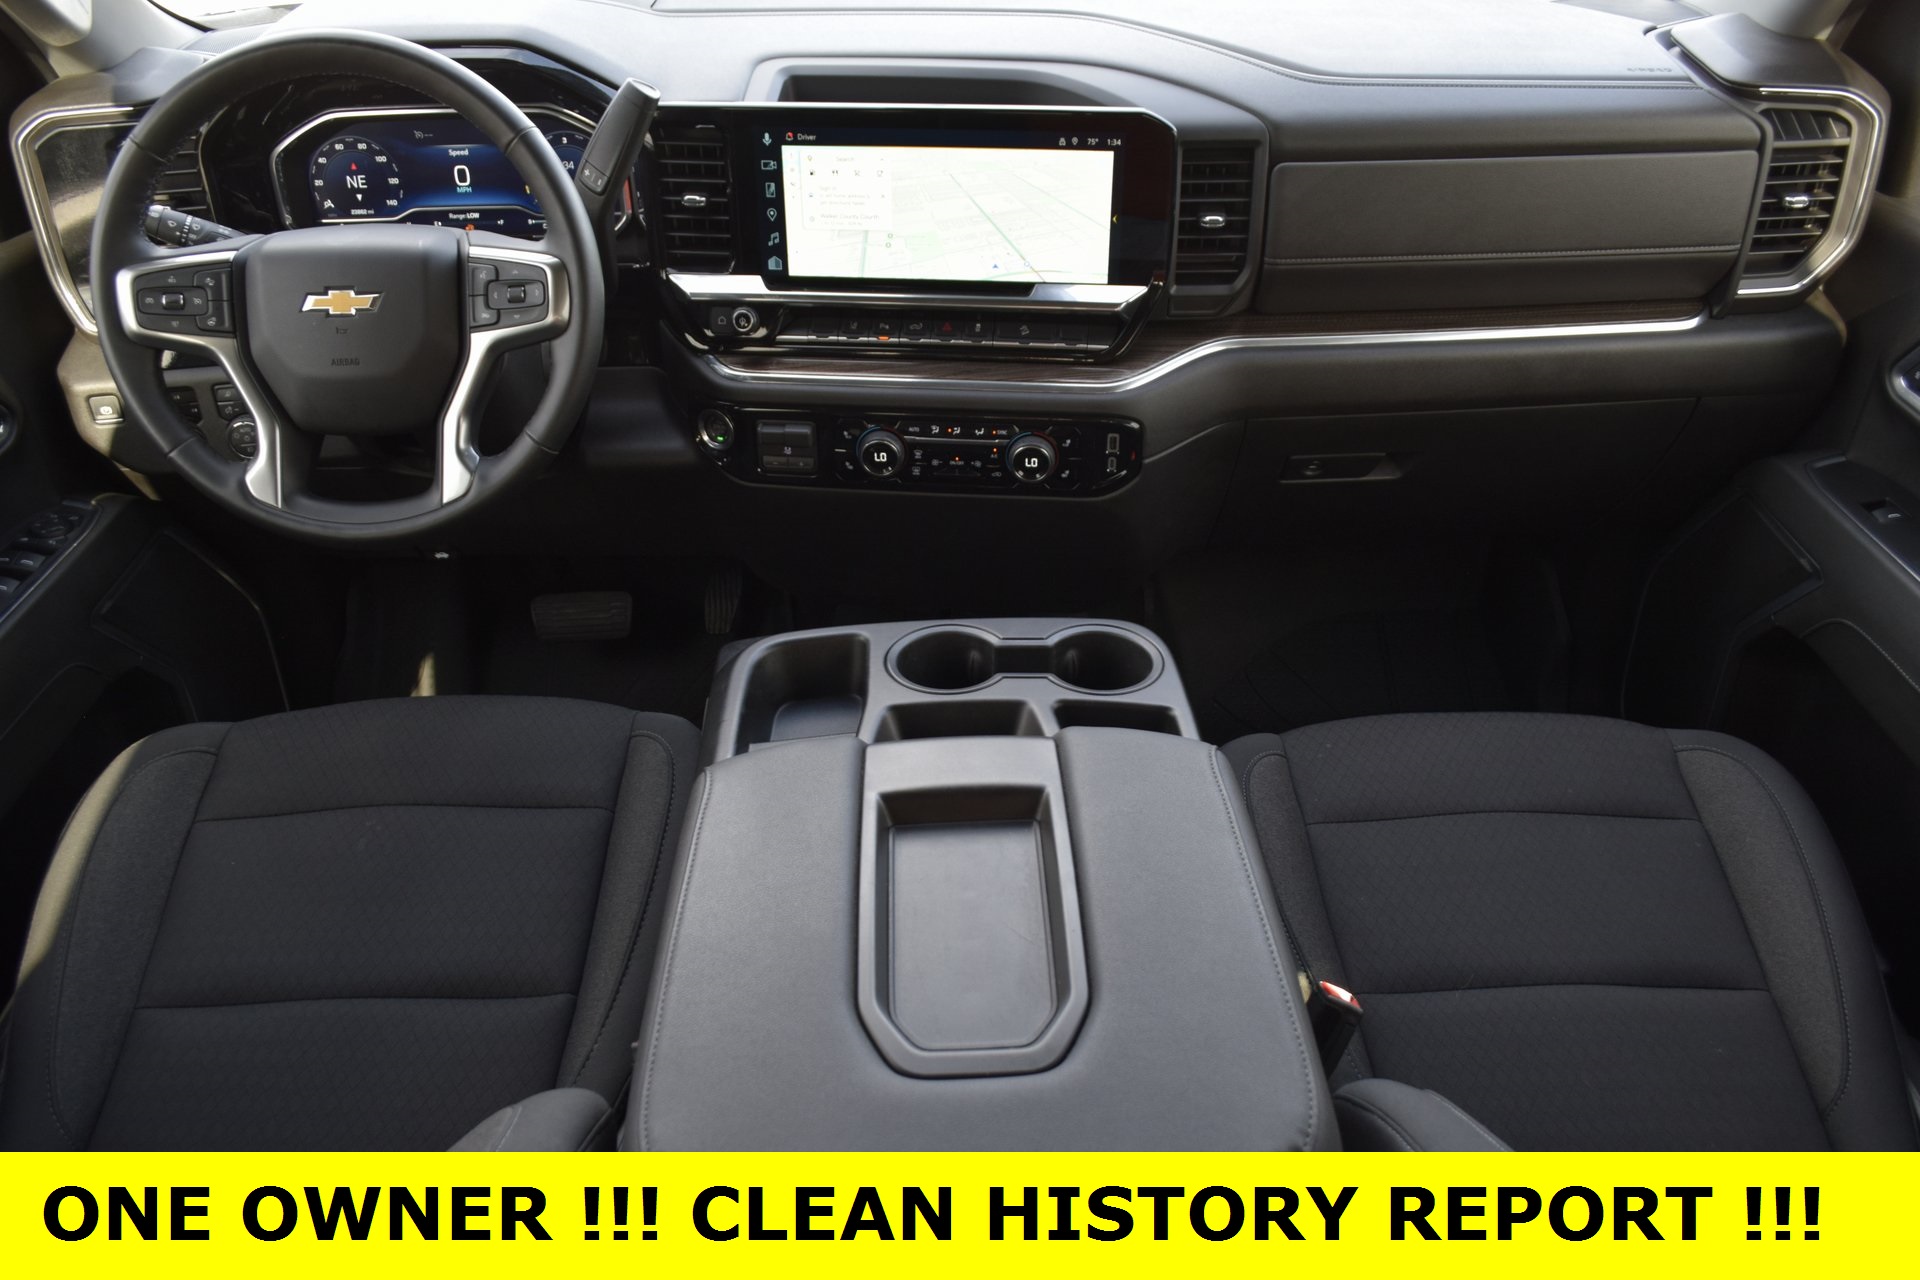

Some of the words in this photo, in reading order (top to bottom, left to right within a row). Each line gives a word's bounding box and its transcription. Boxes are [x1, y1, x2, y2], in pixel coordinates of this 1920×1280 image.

[797, 133, 817, 141] Driver
[1107, 138, 1121, 146] 1:34
[448, 148, 469, 157] Speed
[454, 164, 471, 187] 0
[314, 179, 324, 187] 20
[346, 175, 368, 189] NE
[387, 177, 399, 185] 120
[331, 357, 360, 367] AIRBAG
[874, 451, 887, 462] LO
[1025, 457, 1038, 468] LO
